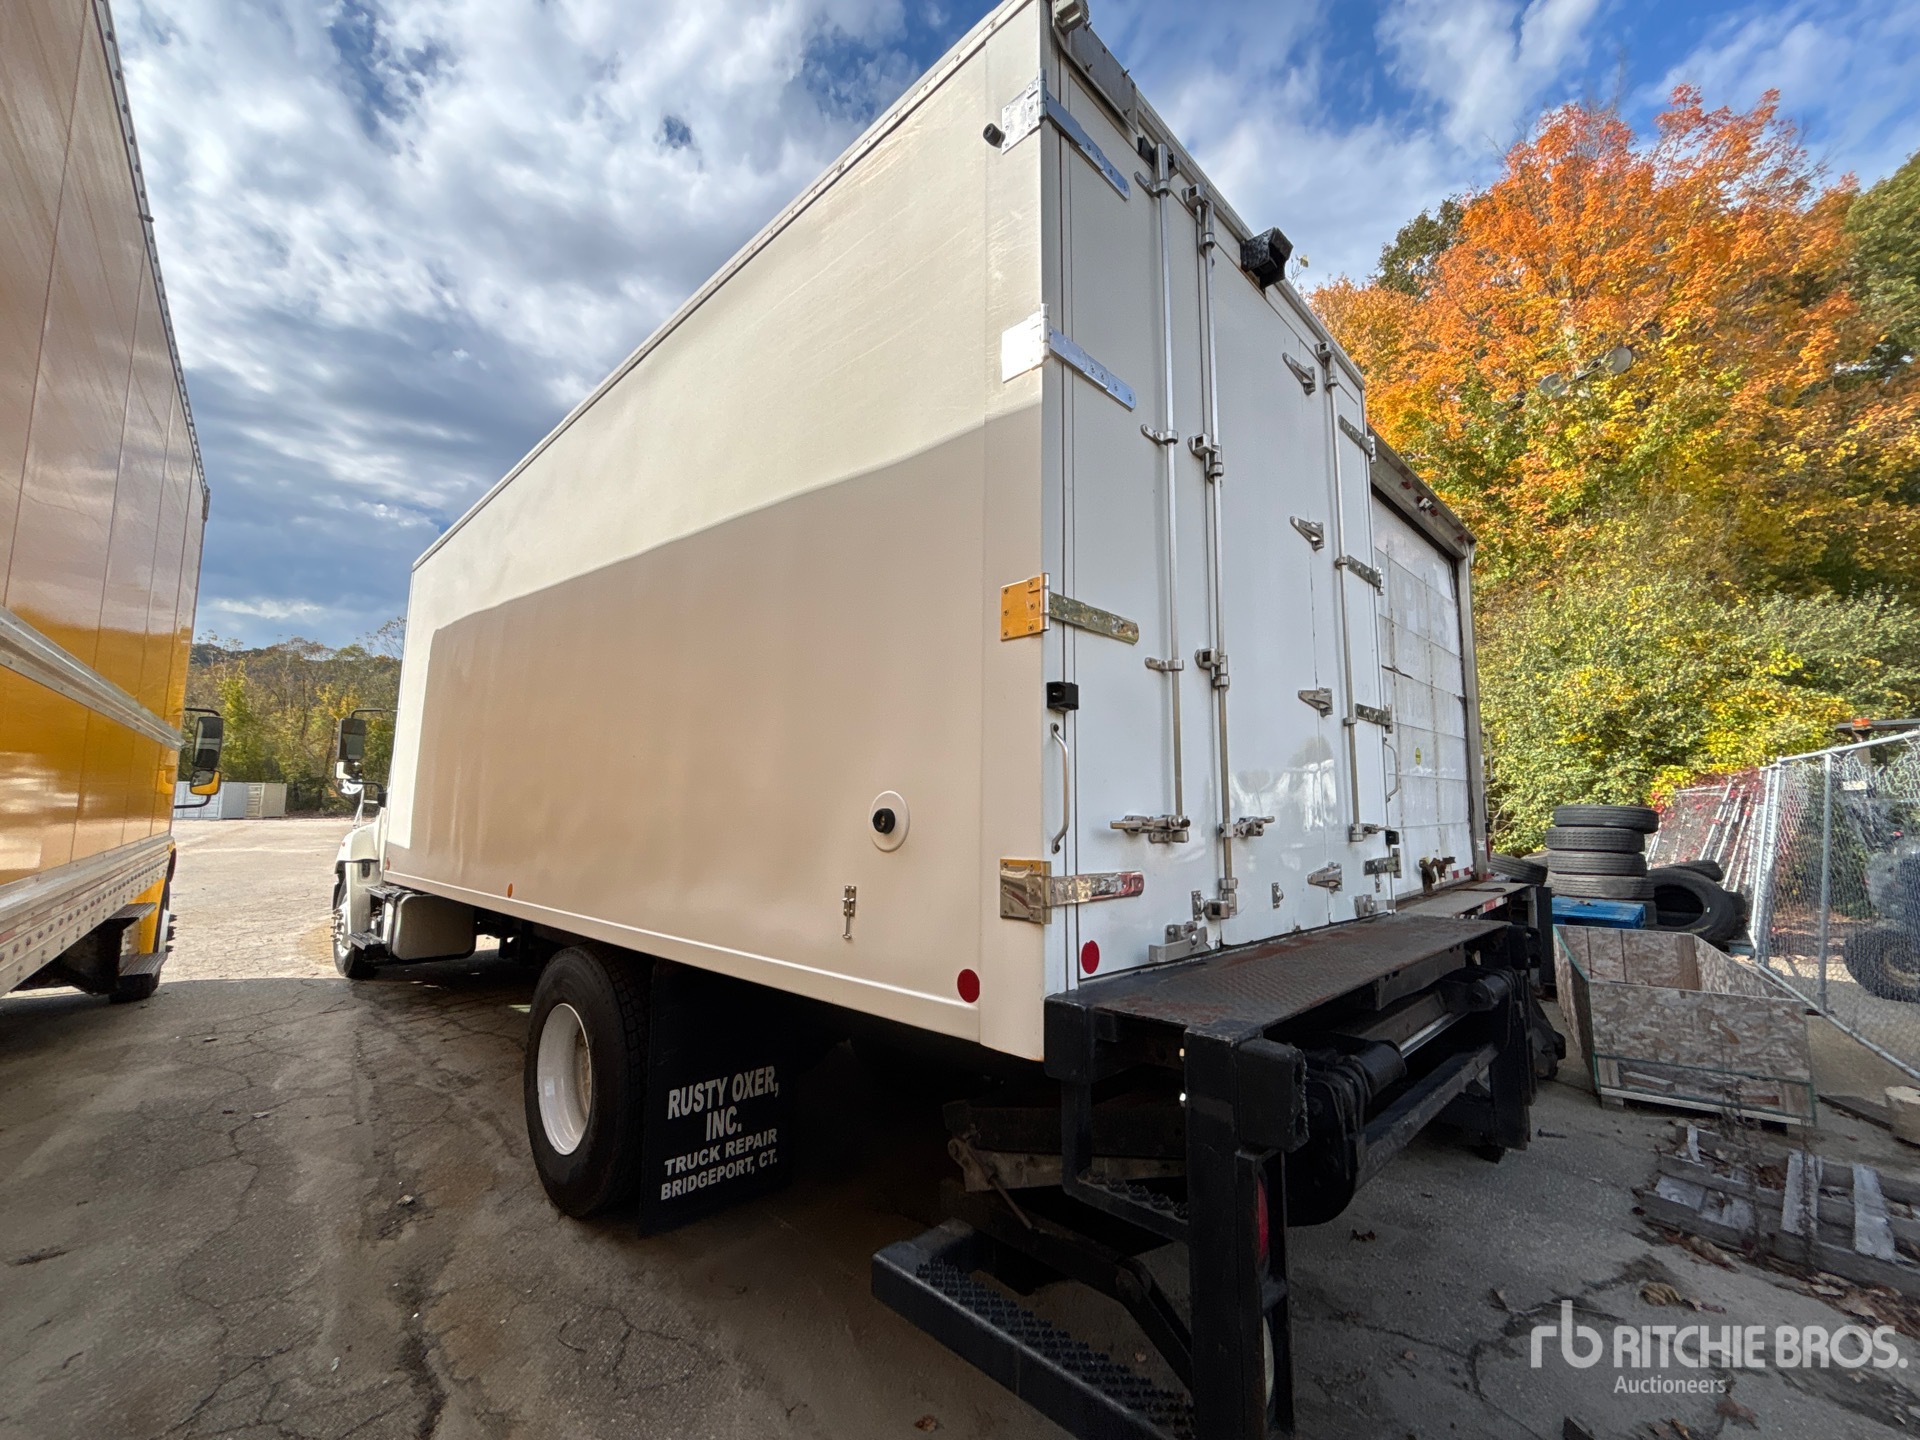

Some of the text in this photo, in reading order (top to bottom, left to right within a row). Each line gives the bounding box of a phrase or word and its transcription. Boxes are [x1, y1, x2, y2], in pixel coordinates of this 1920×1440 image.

[667, 1066, 779, 1119] RUSTY OXER,
[705, 1106, 742, 1141] INC.
[661, 1149, 778, 1200] BRIDGEPORT, CT.
[664, 1128, 778, 1176] TRUCK REPAIR
